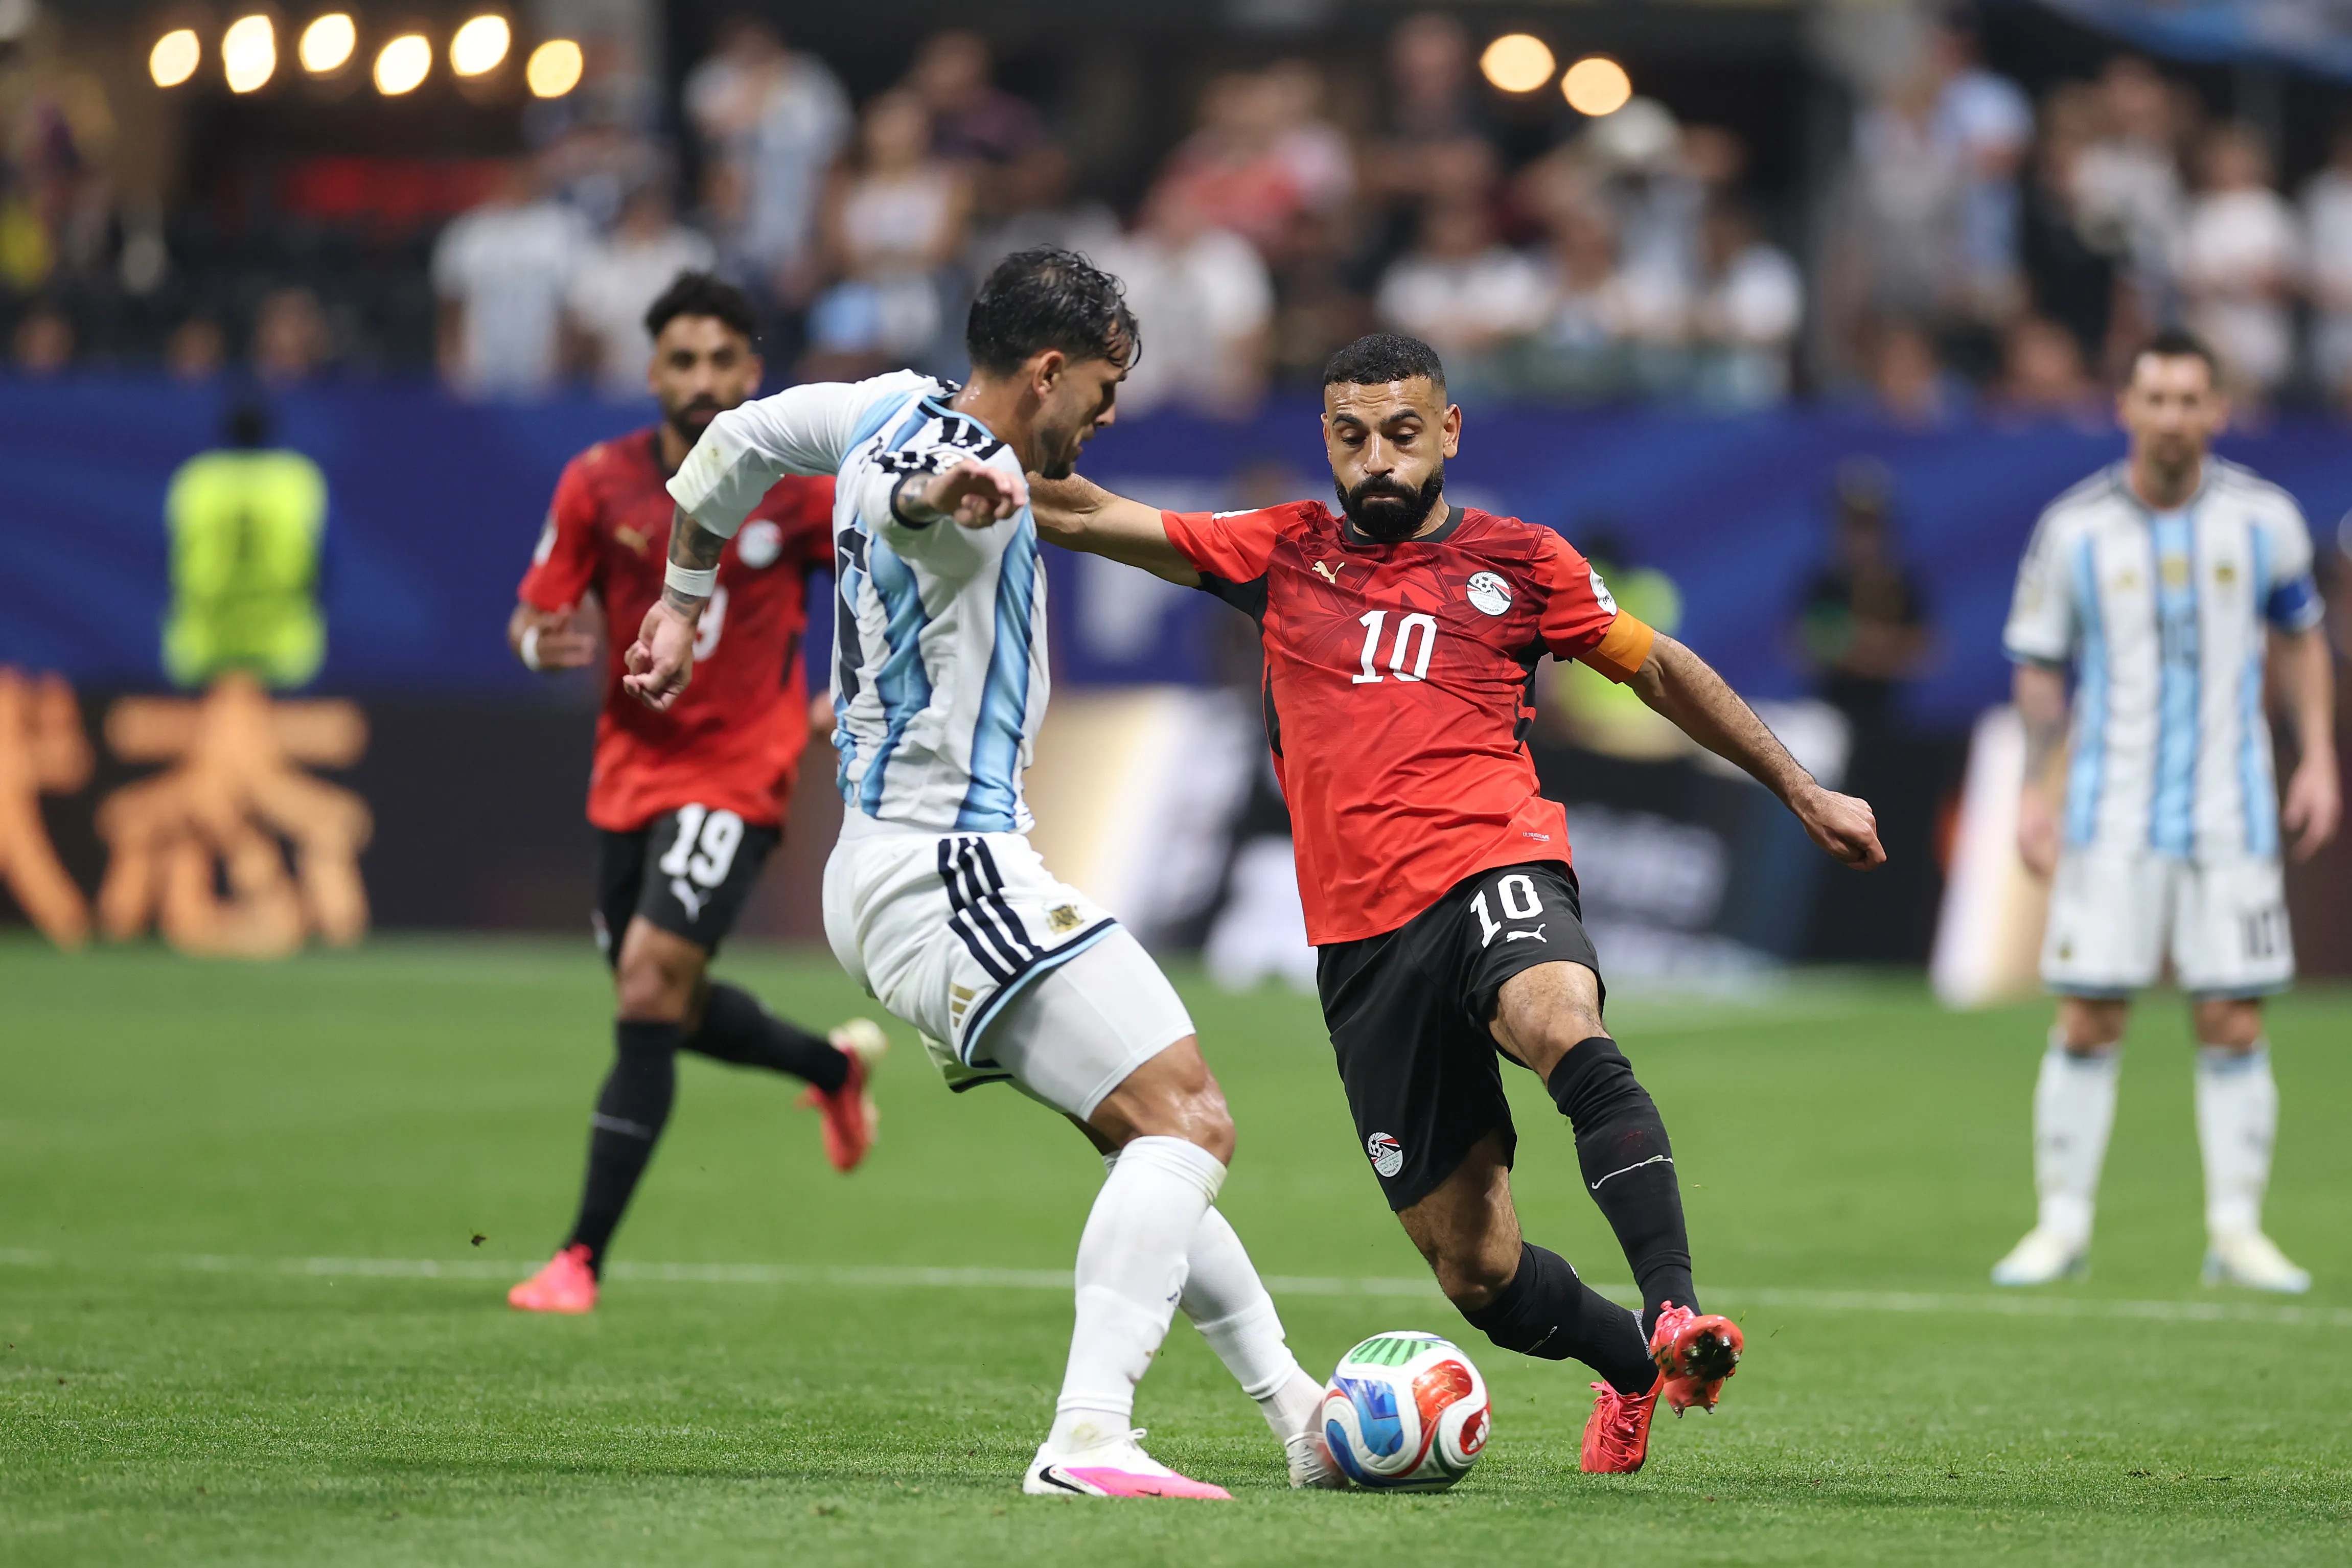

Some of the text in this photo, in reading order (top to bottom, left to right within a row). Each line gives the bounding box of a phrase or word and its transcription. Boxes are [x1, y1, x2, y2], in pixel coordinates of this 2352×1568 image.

[691, 584, 730, 661] 9
[1352, 610, 1437, 684] 10
[659, 802, 743, 887] 19
[1470, 874, 1542, 948] 10
